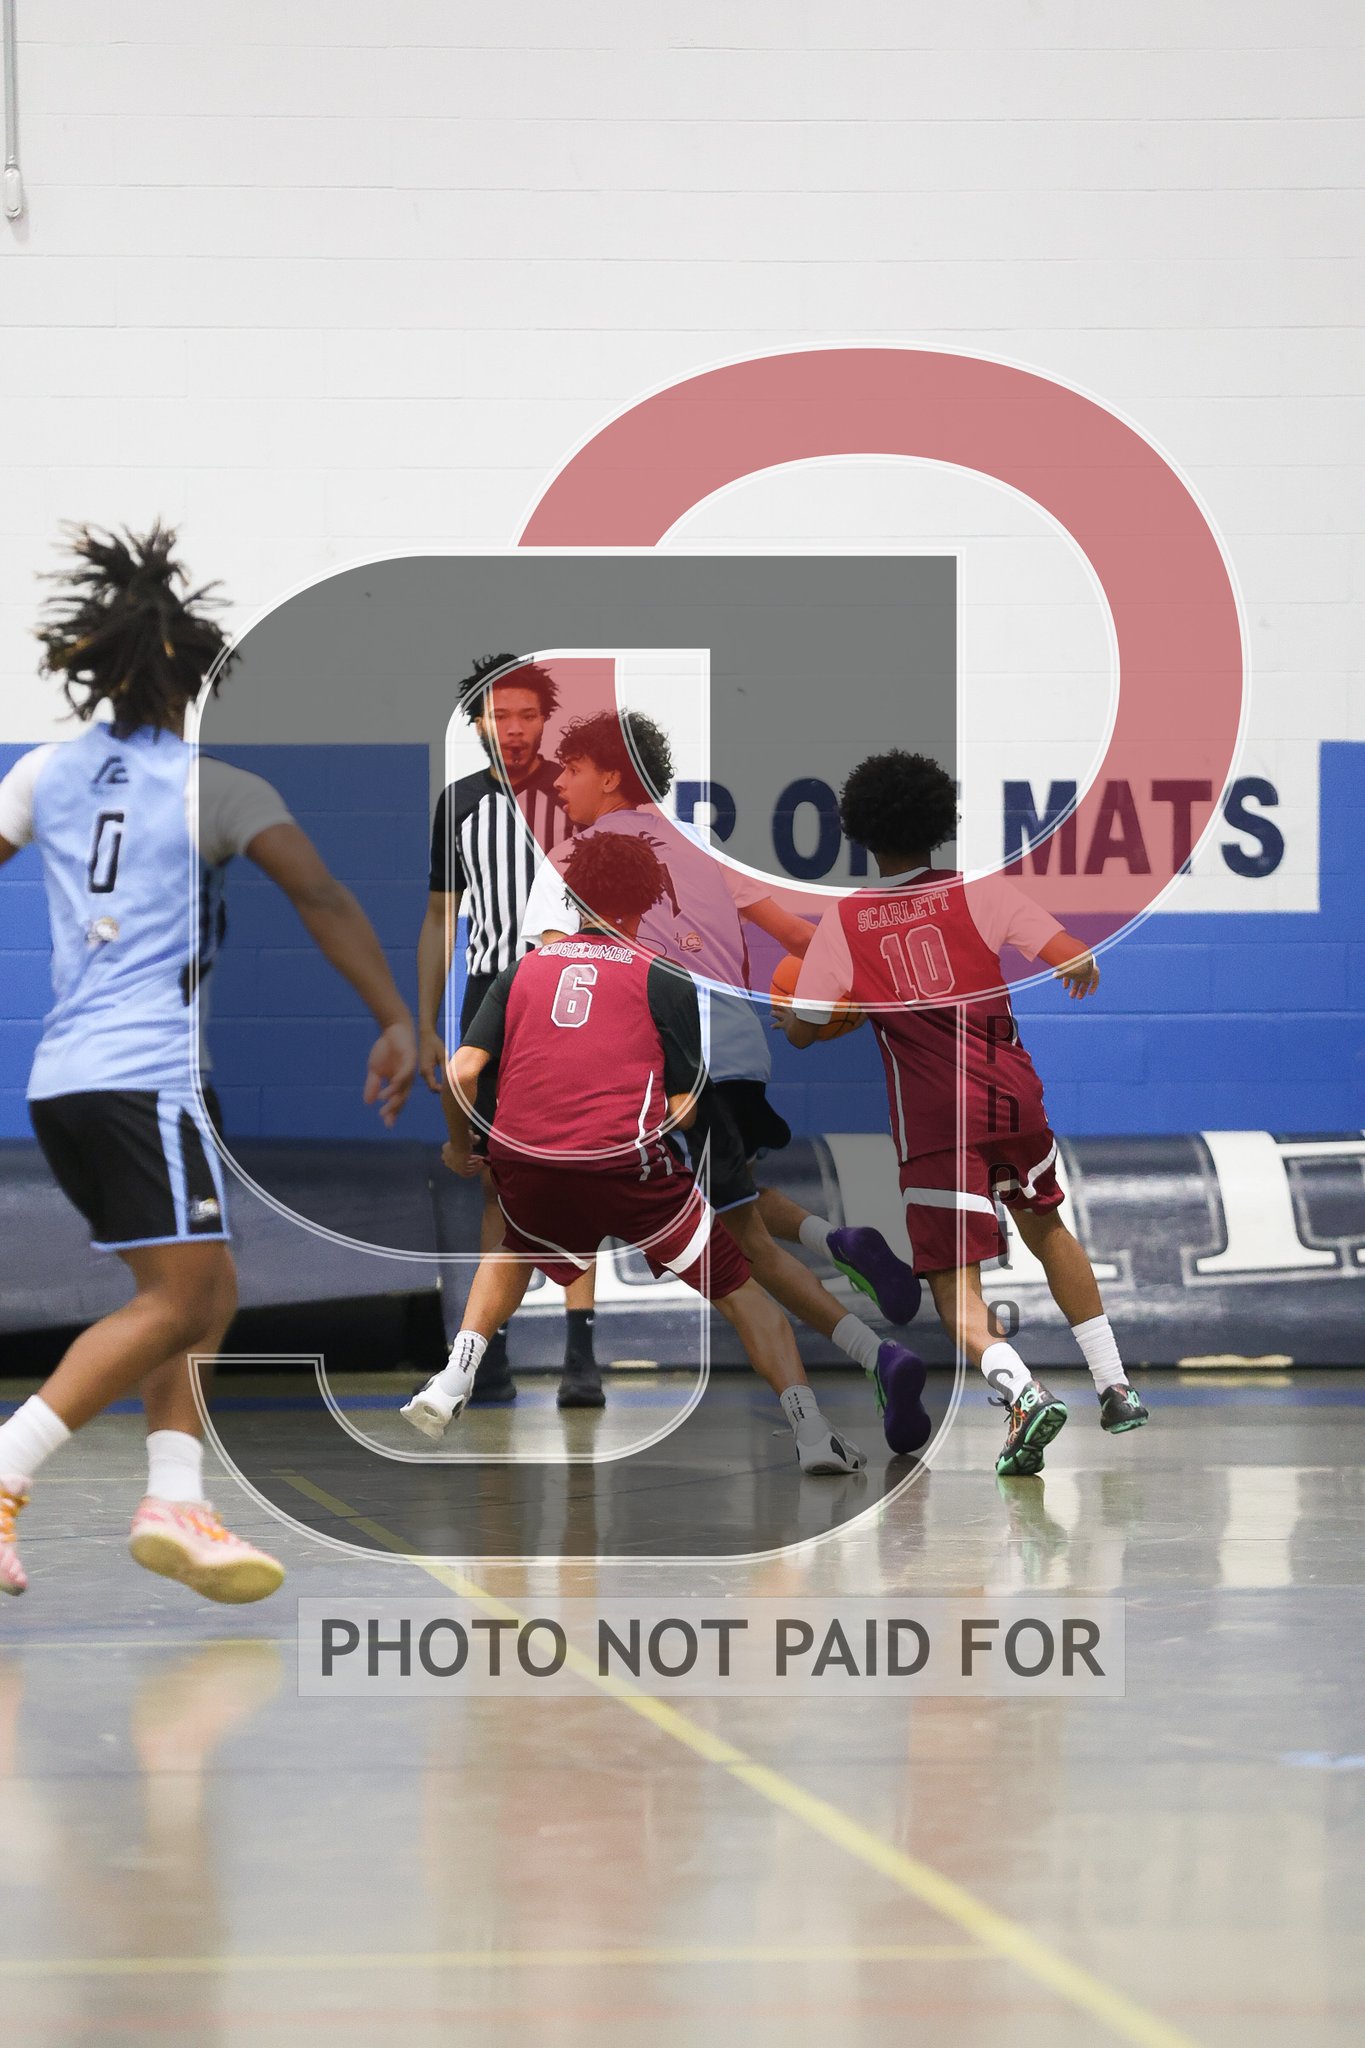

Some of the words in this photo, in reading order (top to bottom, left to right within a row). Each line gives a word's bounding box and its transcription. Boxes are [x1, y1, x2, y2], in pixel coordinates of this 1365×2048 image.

[1002, 776, 1286, 879] MATS
[857, 889, 950, 932] SCARLETT
[550, 964, 598, 1028] 6
[880, 923, 955, 1005] 10
